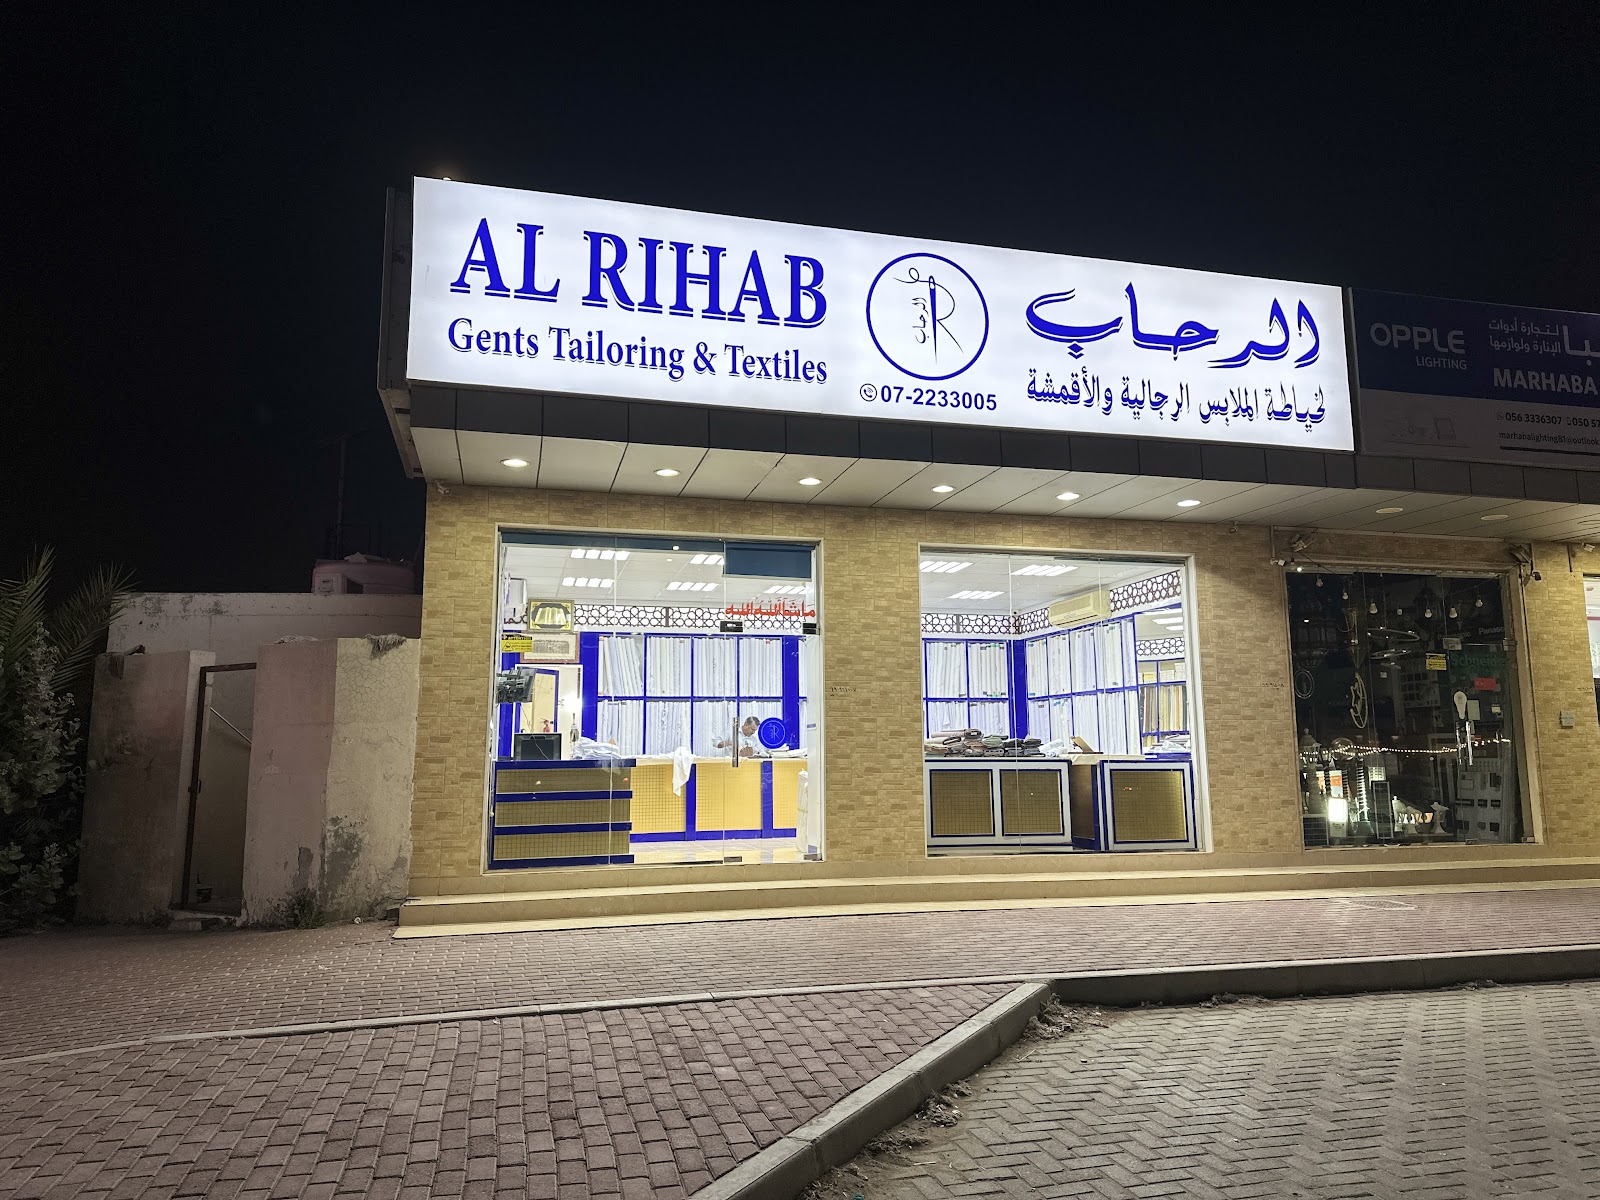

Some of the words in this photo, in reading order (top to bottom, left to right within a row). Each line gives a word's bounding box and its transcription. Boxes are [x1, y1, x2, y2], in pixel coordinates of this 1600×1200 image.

[450, 217, 561, 303] AL
[580, 230, 828, 330] RIHAB
[1025, 281, 1321, 368] الرحاب
[1369, 322, 1466, 355] OPPLE
[448, 317, 539, 357] Gents
[549, 326, 685, 382] Tailoring
[693, 341, 717, 375] &
[725, 344, 828, 384] Textiles
[1415, 356, 1467, 371] LIGHTING
[880, 384, 998, 411] 07-2233005
[1026, 366, 1113, 415] والأقمشة
[1120, 374, 1191, 421] الرجالية
[1493, 367, 1599, 395] MARHABA
[1198, 387, 1259, 426] الملابس
[1505, 412, 1523, 422] 056
[1524, 413, 1562, 425] 3336307
[1572, 417, 1589, 427] 050
